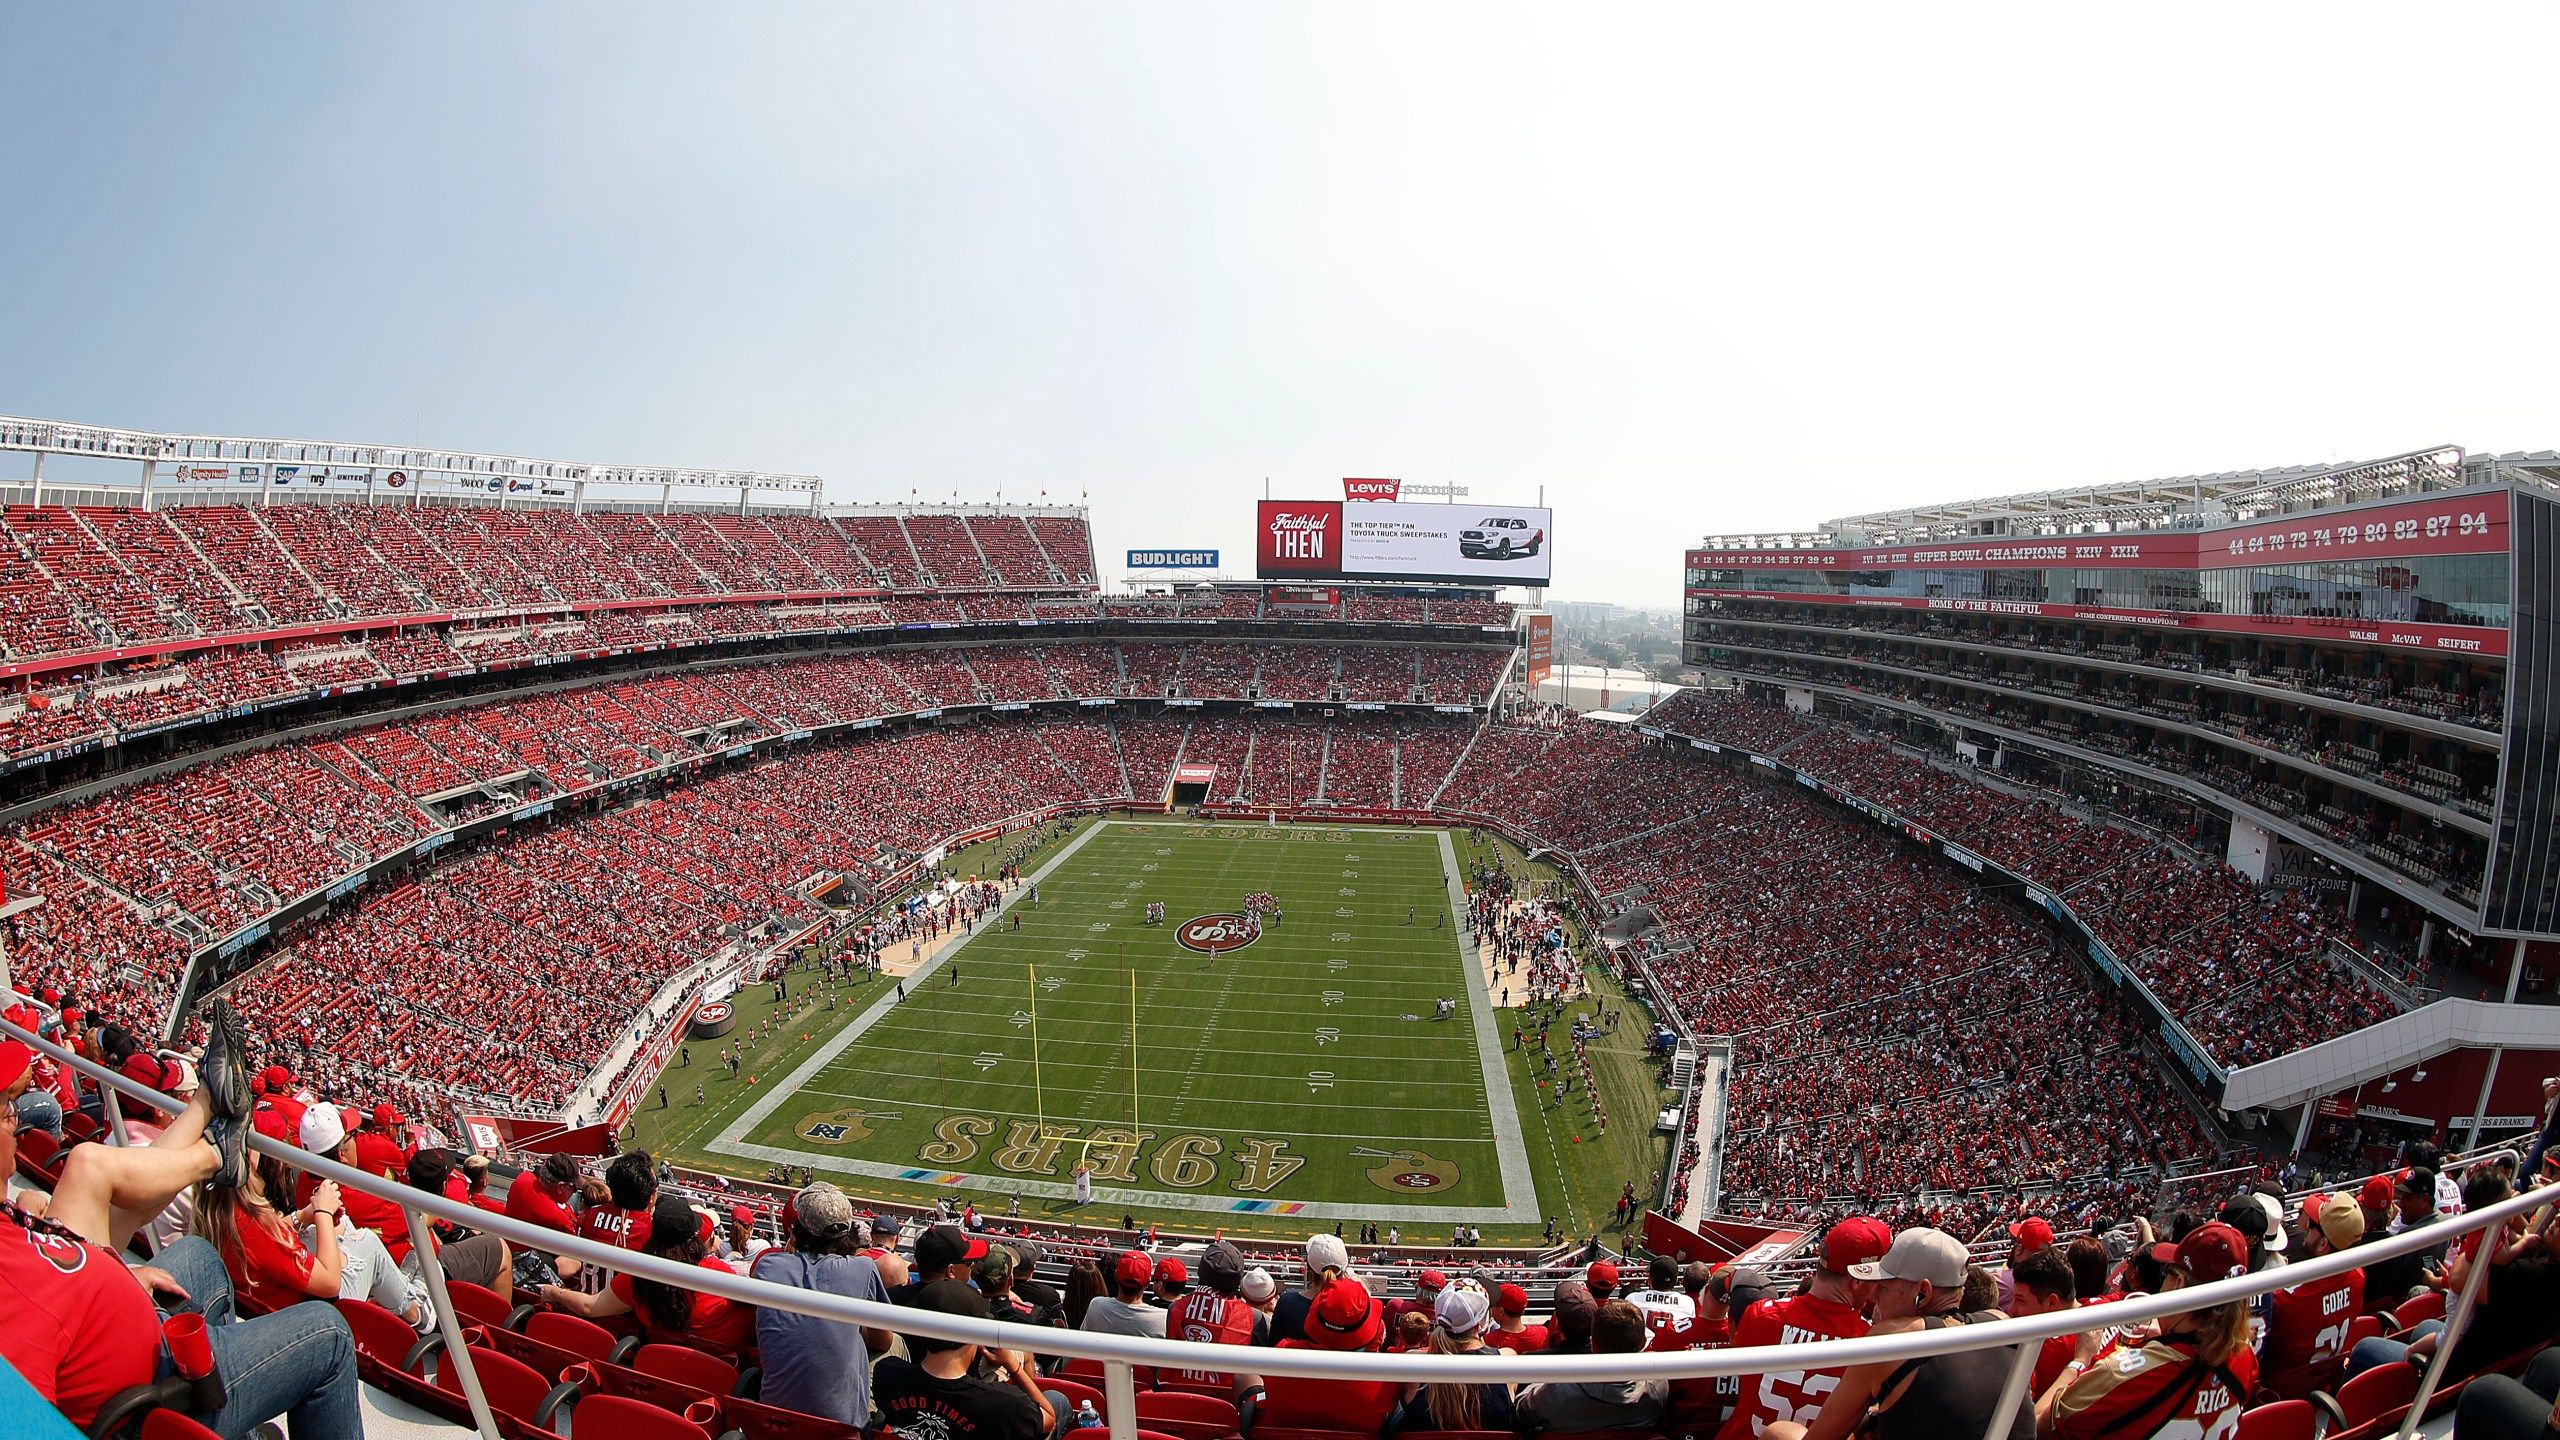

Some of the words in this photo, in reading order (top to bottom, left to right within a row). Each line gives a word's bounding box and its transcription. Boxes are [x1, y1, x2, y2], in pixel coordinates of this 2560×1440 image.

[192, 470, 211, 481] Dignity
[276, 468, 294, 480] SAP
[310, 474, 325, 486] nrg
[460, 478, 485, 489] YAHOO!
[516, 482, 533, 492] pepsi
[1270, 513, 1330, 533] Faithful
[2268, 534, 2285, 550] 70
[2313, 528, 2332, 546] 74
[2337, 525, 2357, 544] 79
[2364, 522, 2387, 542] 80
[2393, 519, 2418, 539] 82
[2425, 515, 2452, 537] 87
[2458, 512, 2488, 535] 94
[1272, 530, 1324, 559] THEN
[1131, 553, 1165, 565] BUD
[1166, 553, 1214, 565] LIGHT
[1739, 556, 1749, 564] 27
[1751, 556, 1762, 564] 33
[1765, 556, 1776, 564] 34
[1778, 556, 1790, 564] 35
[1793, 556, 1804, 564] 37
[1807, 556, 1819, 564] 39
[1822, 556, 1835, 564] 42
[1913, 551, 1947, 563] SUPER
[1950, 549, 1984, 561] BOWL
[1985, 546, 2067, 560] CHAMPIONS
[2075, 546, 2102, 558] XXIV
[2110, 545, 2140, 558] XXIX
[531, 605, 573, 614] CHAMPIONS
[1928, 599, 1953, 610] HOME
[1955, 600, 1966, 610] OF
[1968, 601, 1988, 611] THE
[1990, 602, 2042, 615] FAITHFUL
[2096, 613, 2137, 622] CONFERENCE
[2137, 616, 2179, 626] CHAMPIONS
[2349, 630, 2378, 641] WALSH
[2391, 633, 2422, 645] McVAY
[2437, 638, 2481, 651] SEIFERT
[534, 658, 552, 666] GAME
[553, 656, 571, 664] STATS
[342, 685, 364, 694] PASSING
[17, 756, 44, 768] UNITED
[1182, 826, 1354, 843] 49ERS
[2320, 878, 2348, 891] ZONE
[1320, 990, 1345, 1003] 30
[1314, 1027, 1340, 1042] 20
[973, 1051, 1004, 1067] 10
[624, 1057, 658, 1112] FAITHFUL
[656, 1034, 675, 1066] THEN
[1307, 1071, 1335, 1088] 10
[2365, 1104, 2400, 1116] FRANKS
[2461, 1118, 2492, 1126] TENERS
[2499, 1118, 2526, 1126] FRANKS
[917, 1113, 1308, 1193] 49ERS
[2438, 1187, 2460, 1201] WILLIS
[593, 1212, 634, 1236] RICE
[1646, 1293, 1679, 1306] GARCIA
[2322, 1286, 2351, 1316] GORE
[2309, 1317, 2350, 1365] 21
[2194, 1385, 2230, 1415] RICE
[891, 1396, 927, 1411] GOOD
[935, 1401, 976, 1432] TIMES
